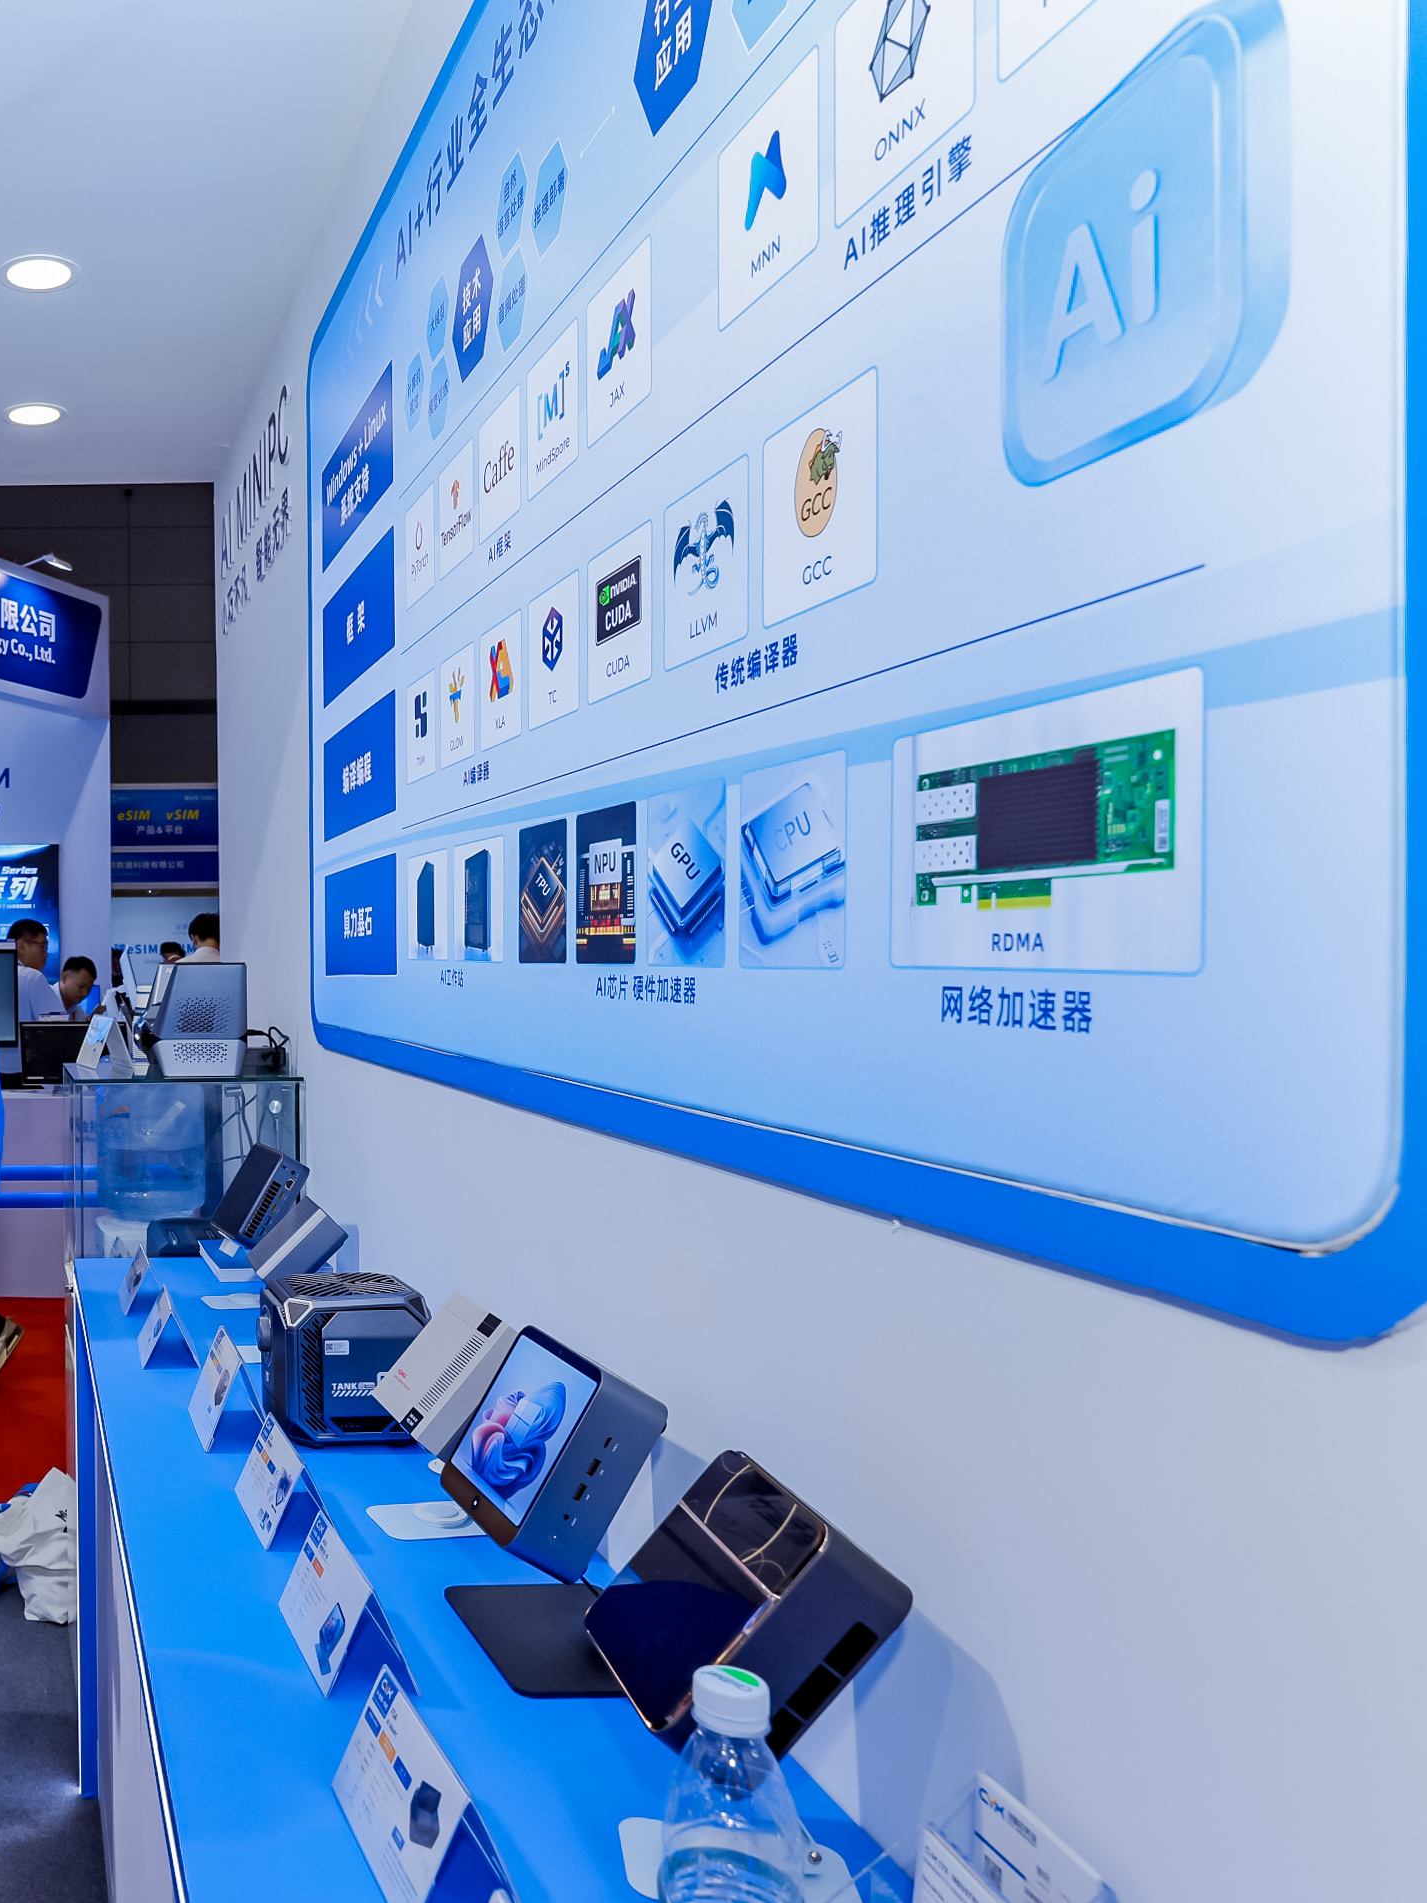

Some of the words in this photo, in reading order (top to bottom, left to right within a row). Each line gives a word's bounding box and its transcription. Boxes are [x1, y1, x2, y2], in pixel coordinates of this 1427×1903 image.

[654, 5, 692, 91] 应用
[395, 0, 556, 281] AI+行业全生态
[874, 98, 927, 162] ONNX
[844, 134, 973, 271] AI推理引擎
[751, 237, 782, 278] MNN
[462, 266, 482, 316] 技术
[462, 303, 482, 352] 应用
[609, 382, 625, 408] JAX
[237, 385, 290, 550] MINIPC
[326, 448, 358, 507] Windows
[364, 401, 387, 451] Linux
[483, 440, 515, 494] Caffe
[535, 436, 570, 476] MindSpore
[801, 486, 832, 524] GCC
[440, 508, 472, 548] TensorFlow
[487, 530, 512, 565] AI框架
[802, 555, 833, 586] GCC
[346, 599, 366, 645] 框架
[605, 600, 634, 632] CUDA
[689, 611, 718, 641] LLVM
[10, 637, 33, 661] Co.,
[34, 643, 57, 665] Ltd.
[606, 653, 630, 678] CUDA
[714, 633, 799, 694] 传统编译器
[548, 690, 558, 705] TC
[116, 810, 151, 821] eSIM
[166, 809, 200, 821] vSIM
[1, 866, 38, 875] Series
[593, 848, 617, 875] NPU
[670, 841, 700, 882] GPU
[536, 871, 551, 897] TPU
[343, 905, 373, 940] 算力基石
[991, 932, 1044, 952] RDMA
[595, 974, 628, 1001] AI芯片
[632, 974, 697, 1005] 硬件加速器
[941, 985, 1093, 1034] 网络加速器
[332, 1382, 358, 1390] TANK
